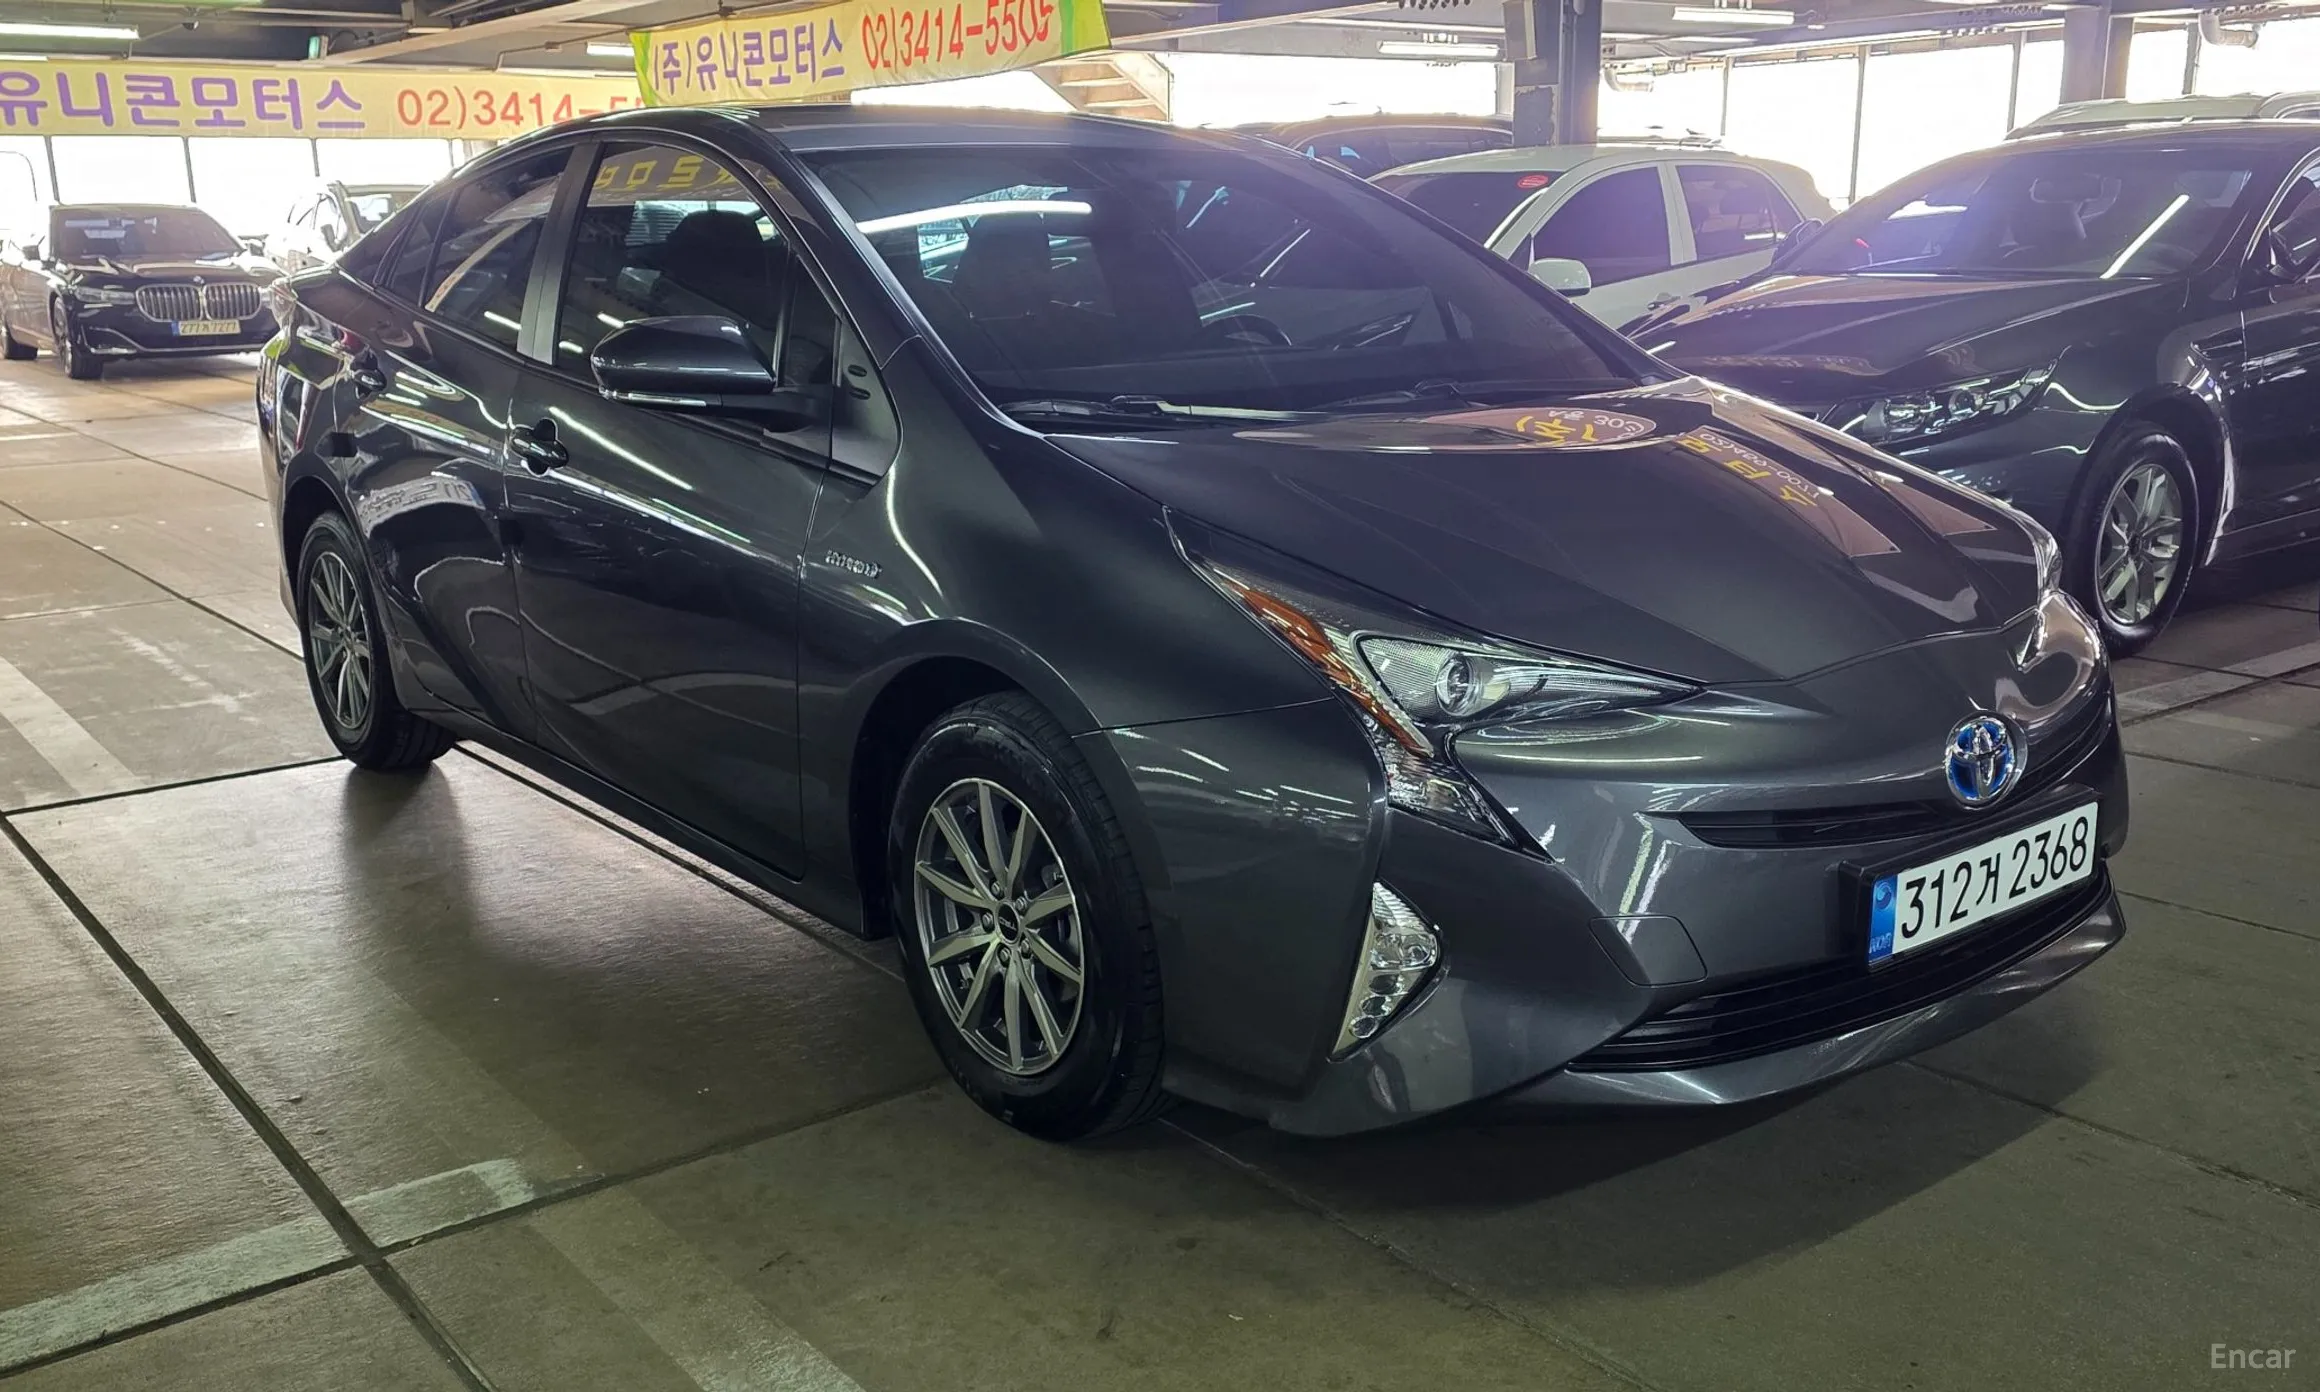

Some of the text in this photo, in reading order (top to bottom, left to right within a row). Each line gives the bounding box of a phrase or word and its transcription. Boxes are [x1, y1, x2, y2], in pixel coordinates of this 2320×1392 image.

[655, 18, 845, 95] (주)유니콘모터스
[0, 71, 644, 130] 유니콘모터스 02)3414-
[1901, 816, 2088, 938] 312거 2368
